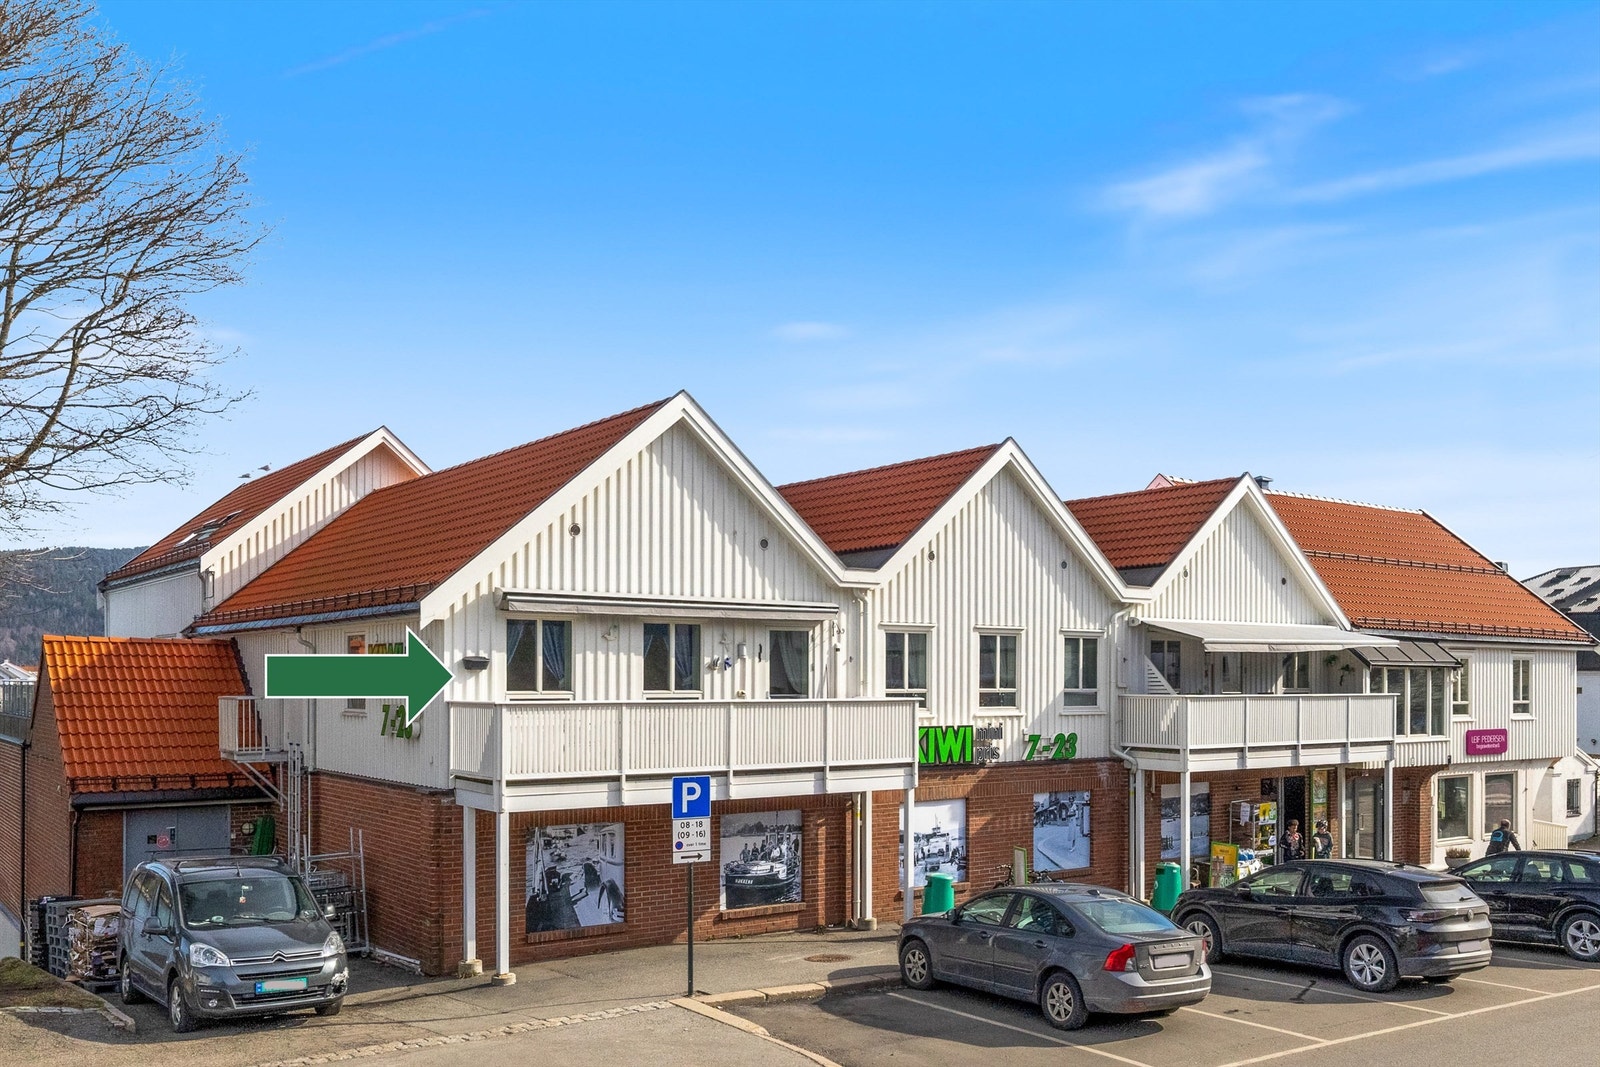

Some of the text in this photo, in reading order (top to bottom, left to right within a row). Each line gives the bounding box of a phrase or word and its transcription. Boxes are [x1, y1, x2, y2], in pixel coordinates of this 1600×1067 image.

[976, 722, 1003, 741] mini
[1471, 734, 1505, 744] LEIF PEDERSEN
[918, 725, 974, 765] KIWI
[976, 743, 1000, 764] pris
[682, 782, 702, 814] P
